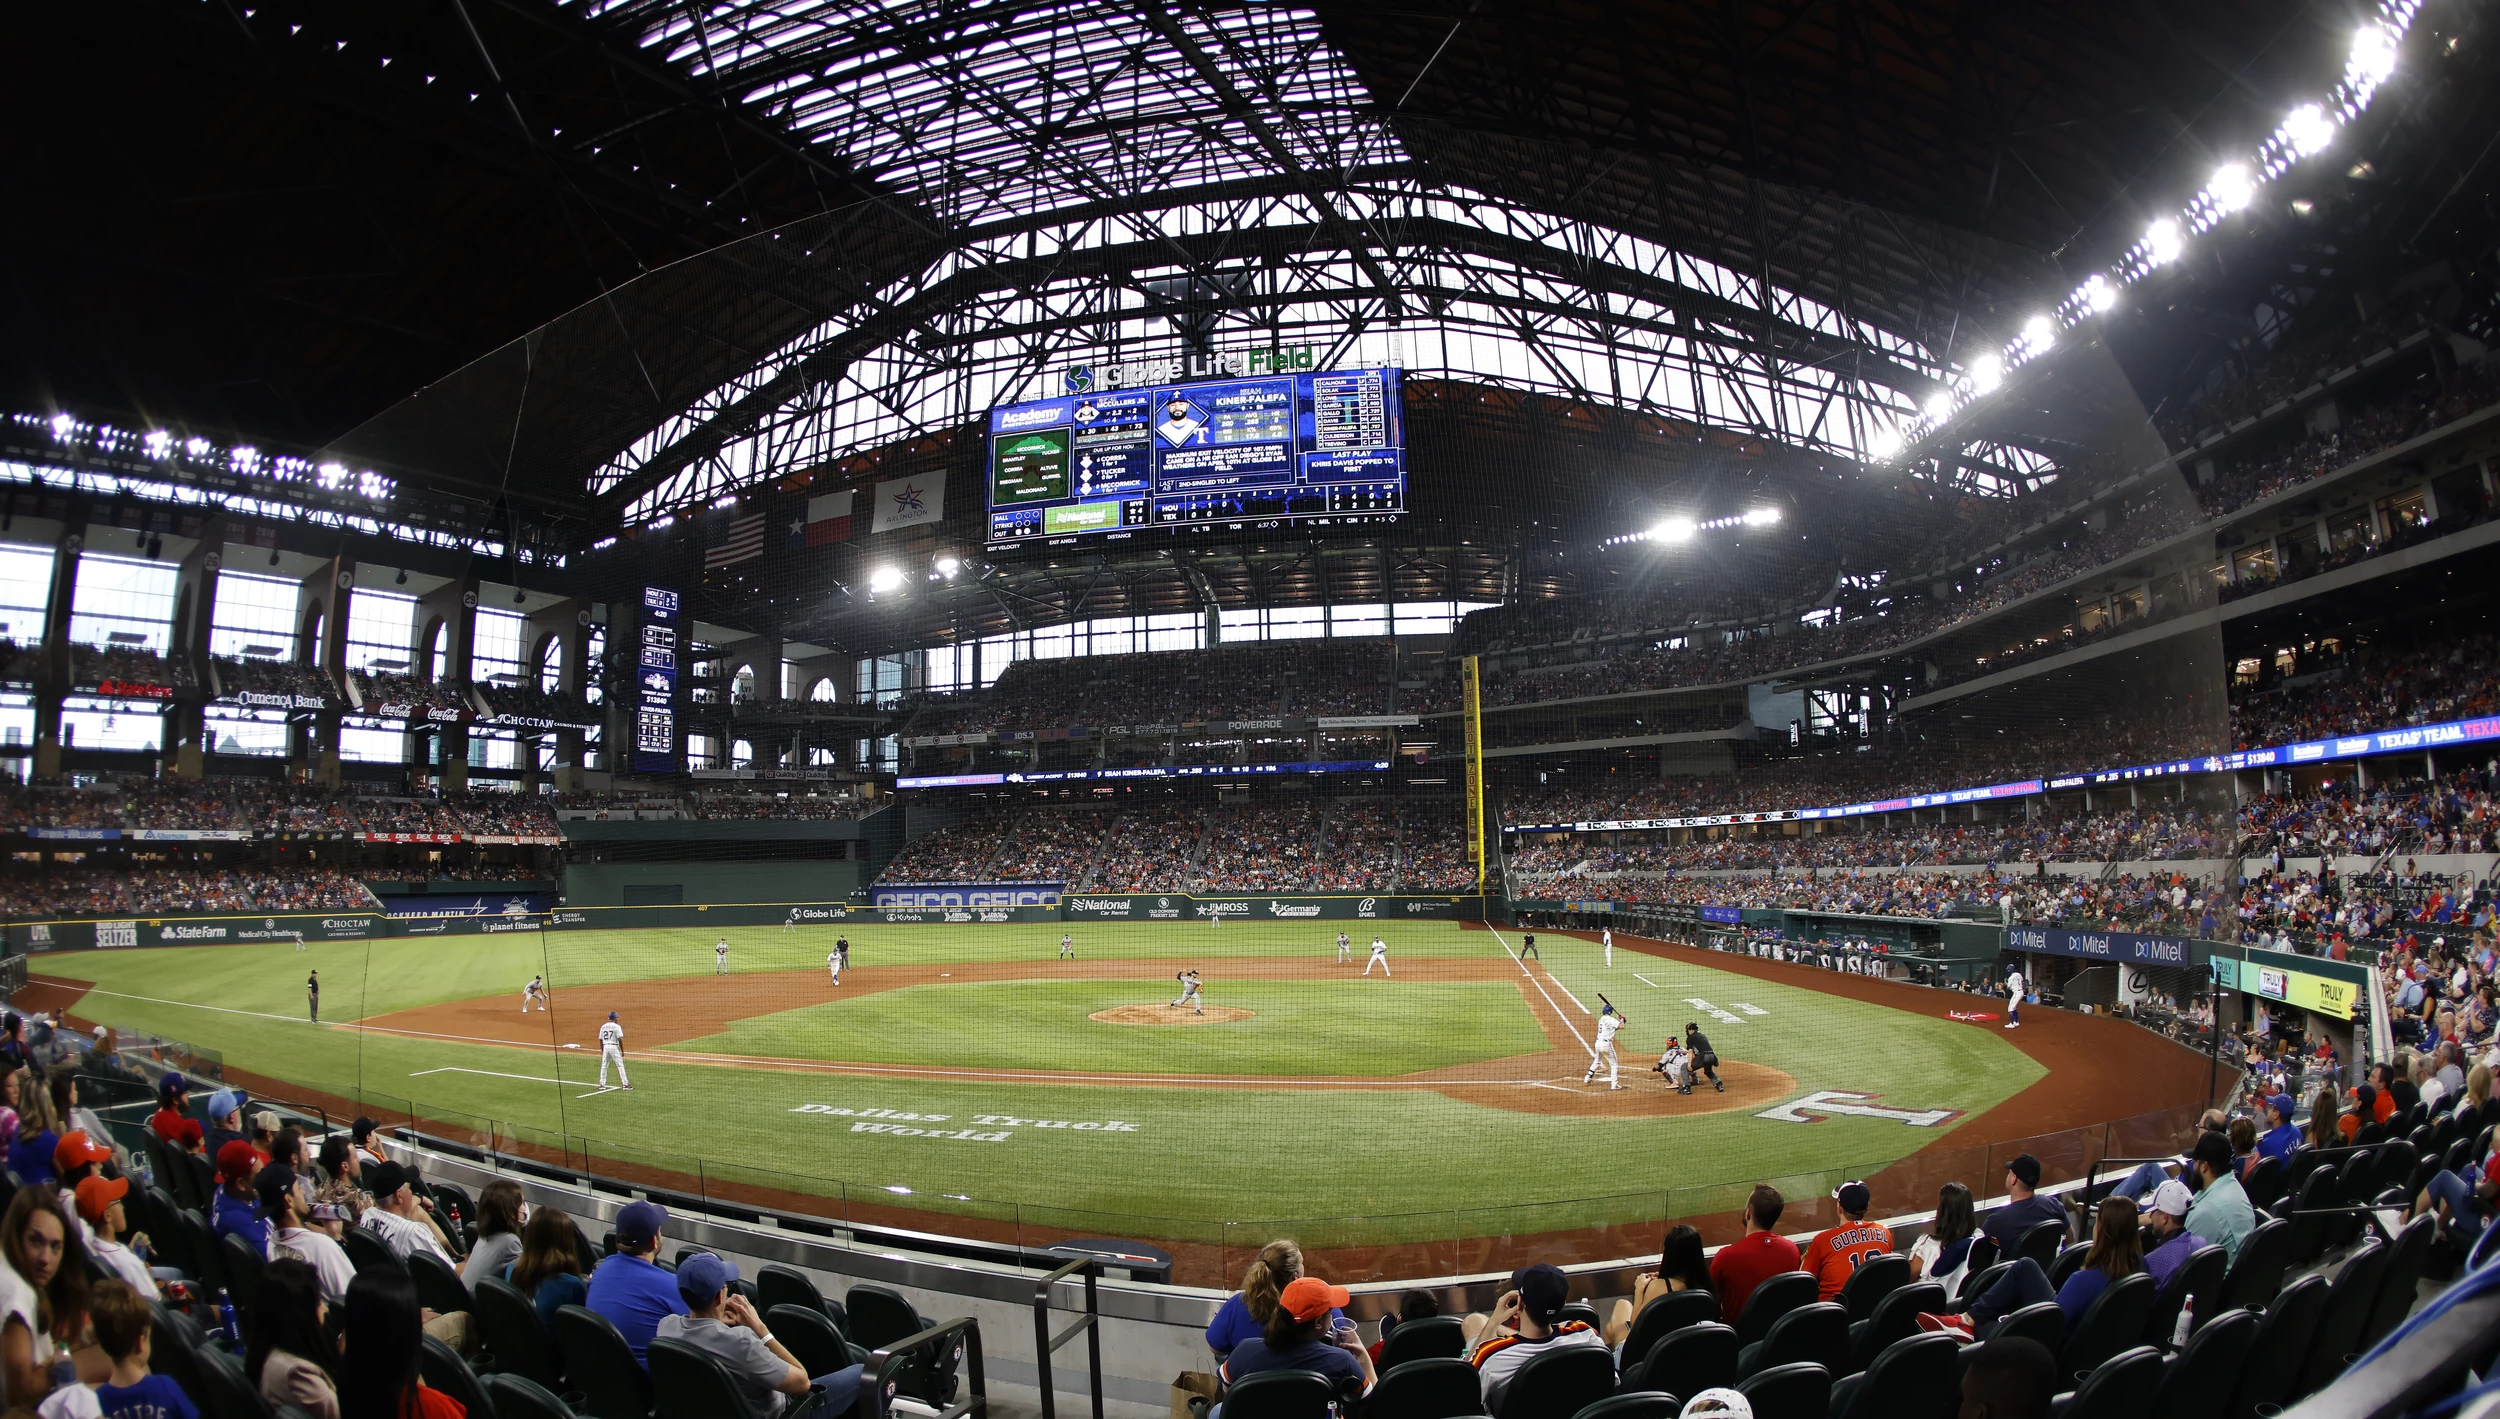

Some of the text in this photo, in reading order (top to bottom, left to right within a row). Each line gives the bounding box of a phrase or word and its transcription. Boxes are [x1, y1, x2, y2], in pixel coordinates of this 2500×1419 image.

[1102, 344, 1313, 386] Globe Life Field
[1097, 399, 1135, 408] MCCULLERS
[1216, 393, 1286, 406] KINER-FALEFA
[1002, 408, 1061, 424] Academy
[1166, 450, 1197, 459] MAXIMUM
[1213, 447, 1241, 455] VELOCITY
[1332, 450, 1372, 459] LAST PLAY
[1163, 462, 1196, 470] WEATHERS
[1101, 480, 1140, 489] MCCORMICK
[1179, 479, 1216, 487] 2ND-SINGLED
[1016, 486, 1048, 495] MALDONADO
[1162, 504, 1178, 512] HOU
[886, 509, 928, 523] ARLINGTON
[1067, 510, 1106, 522] National
[998, 543, 1020, 551] VELOCITY
[294, 694, 325, 709] Bank
[1465, 679, 1474, 712] THE
[502, 713, 554, 729] CHOCTAW
[1228, 719, 1282, 730] POWERADE
[1110, 725, 1130, 734] PGL
[2378, 717, 2500, 749] TEXAS' TEAM. TEXA
[1013, 732, 1034, 740] 105.3
[1467, 723, 1475, 755] HOT
[2247, 751, 2275, 764] $13840
[2051, 777, 2084, 788] KINER-FALEFA
[2179, 763, 2190, 772] 186
[1468, 763, 1476, 809] ZONE
[1951, 791, 1972, 802] TEXAS'
[1972, 788, 1991, 799] TEAM.
[2015, 782, 2039, 795] STORE.
[156, 832, 188, 840] Albertsons
[475, 835, 516, 844] WHATABURGER
[876, 891, 1061, 912] GEICO GEICO
[1085, 899, 1131, 910] National
[385, 909, 465, 919] OCKHEED MARTIN
[803, 908, 846, 920] Globe Life
[1284, 904, 1321, 913] Germania
[96, 921, 136, 930] BUD LIGHT
[327, 919, 371, 928] CHOCTAW
[490, 920, 540, 931] planet fitness
[31, 925, 50, 941] UTA
[96, 928, 138, 948] SELTZER
[238, 930, 271, 939] Medical City
[2023, 931, 2046, 948] Mitel
[2082, 935, 2109, 954] Mitel
[2151, 941, 2182, 961] Mitel
[2263, 973, 2281, 985] TRULY
[2320, 983, 2344, 1002] TRULY
[603, 1031, 614, 1040] 27
[787, 1103, 1142, 1132] Dallas Truck
[850, 1122, 1013, 1142] World
[1830, 1227, 1889, 1251] GURRIEL
